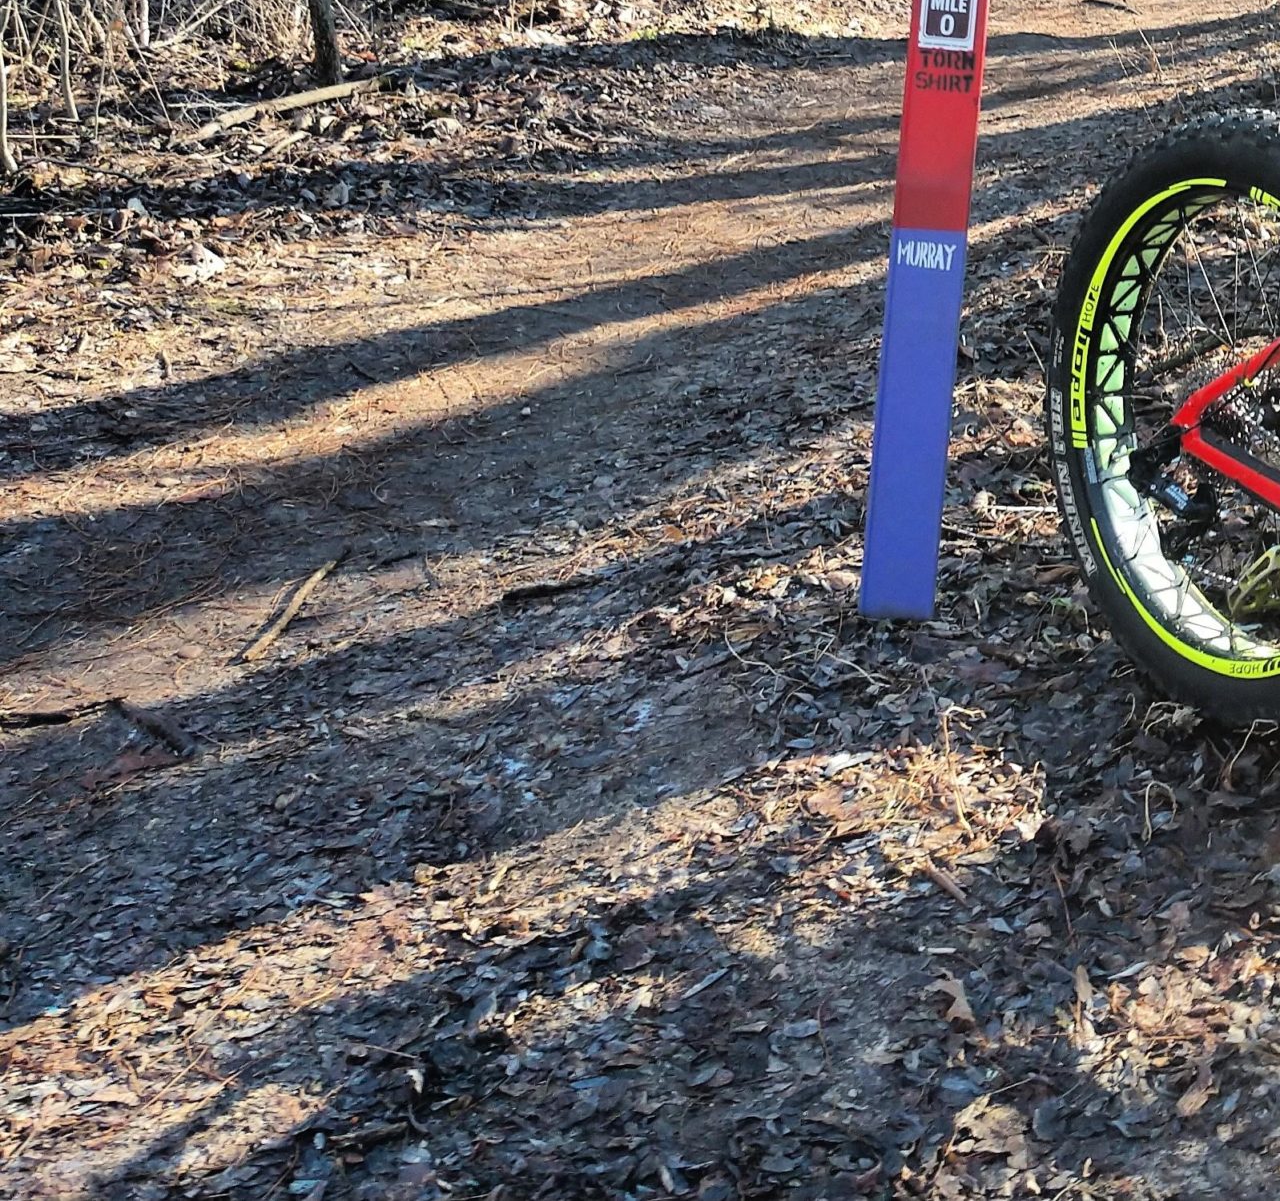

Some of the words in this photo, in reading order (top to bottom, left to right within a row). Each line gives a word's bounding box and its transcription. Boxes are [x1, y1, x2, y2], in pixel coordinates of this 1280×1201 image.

[939, 13, 955, 36] 0
[920, 50, 975, 71] TORN
[915, 72, 974, 94] SHIRT
[897, 239, 957, 271] MURRAY
[1082, 283, 1101, 325] HOPE
[1056, 461, 1098, 577] MINION
[1229, 663, 1260, 675] HOPE
